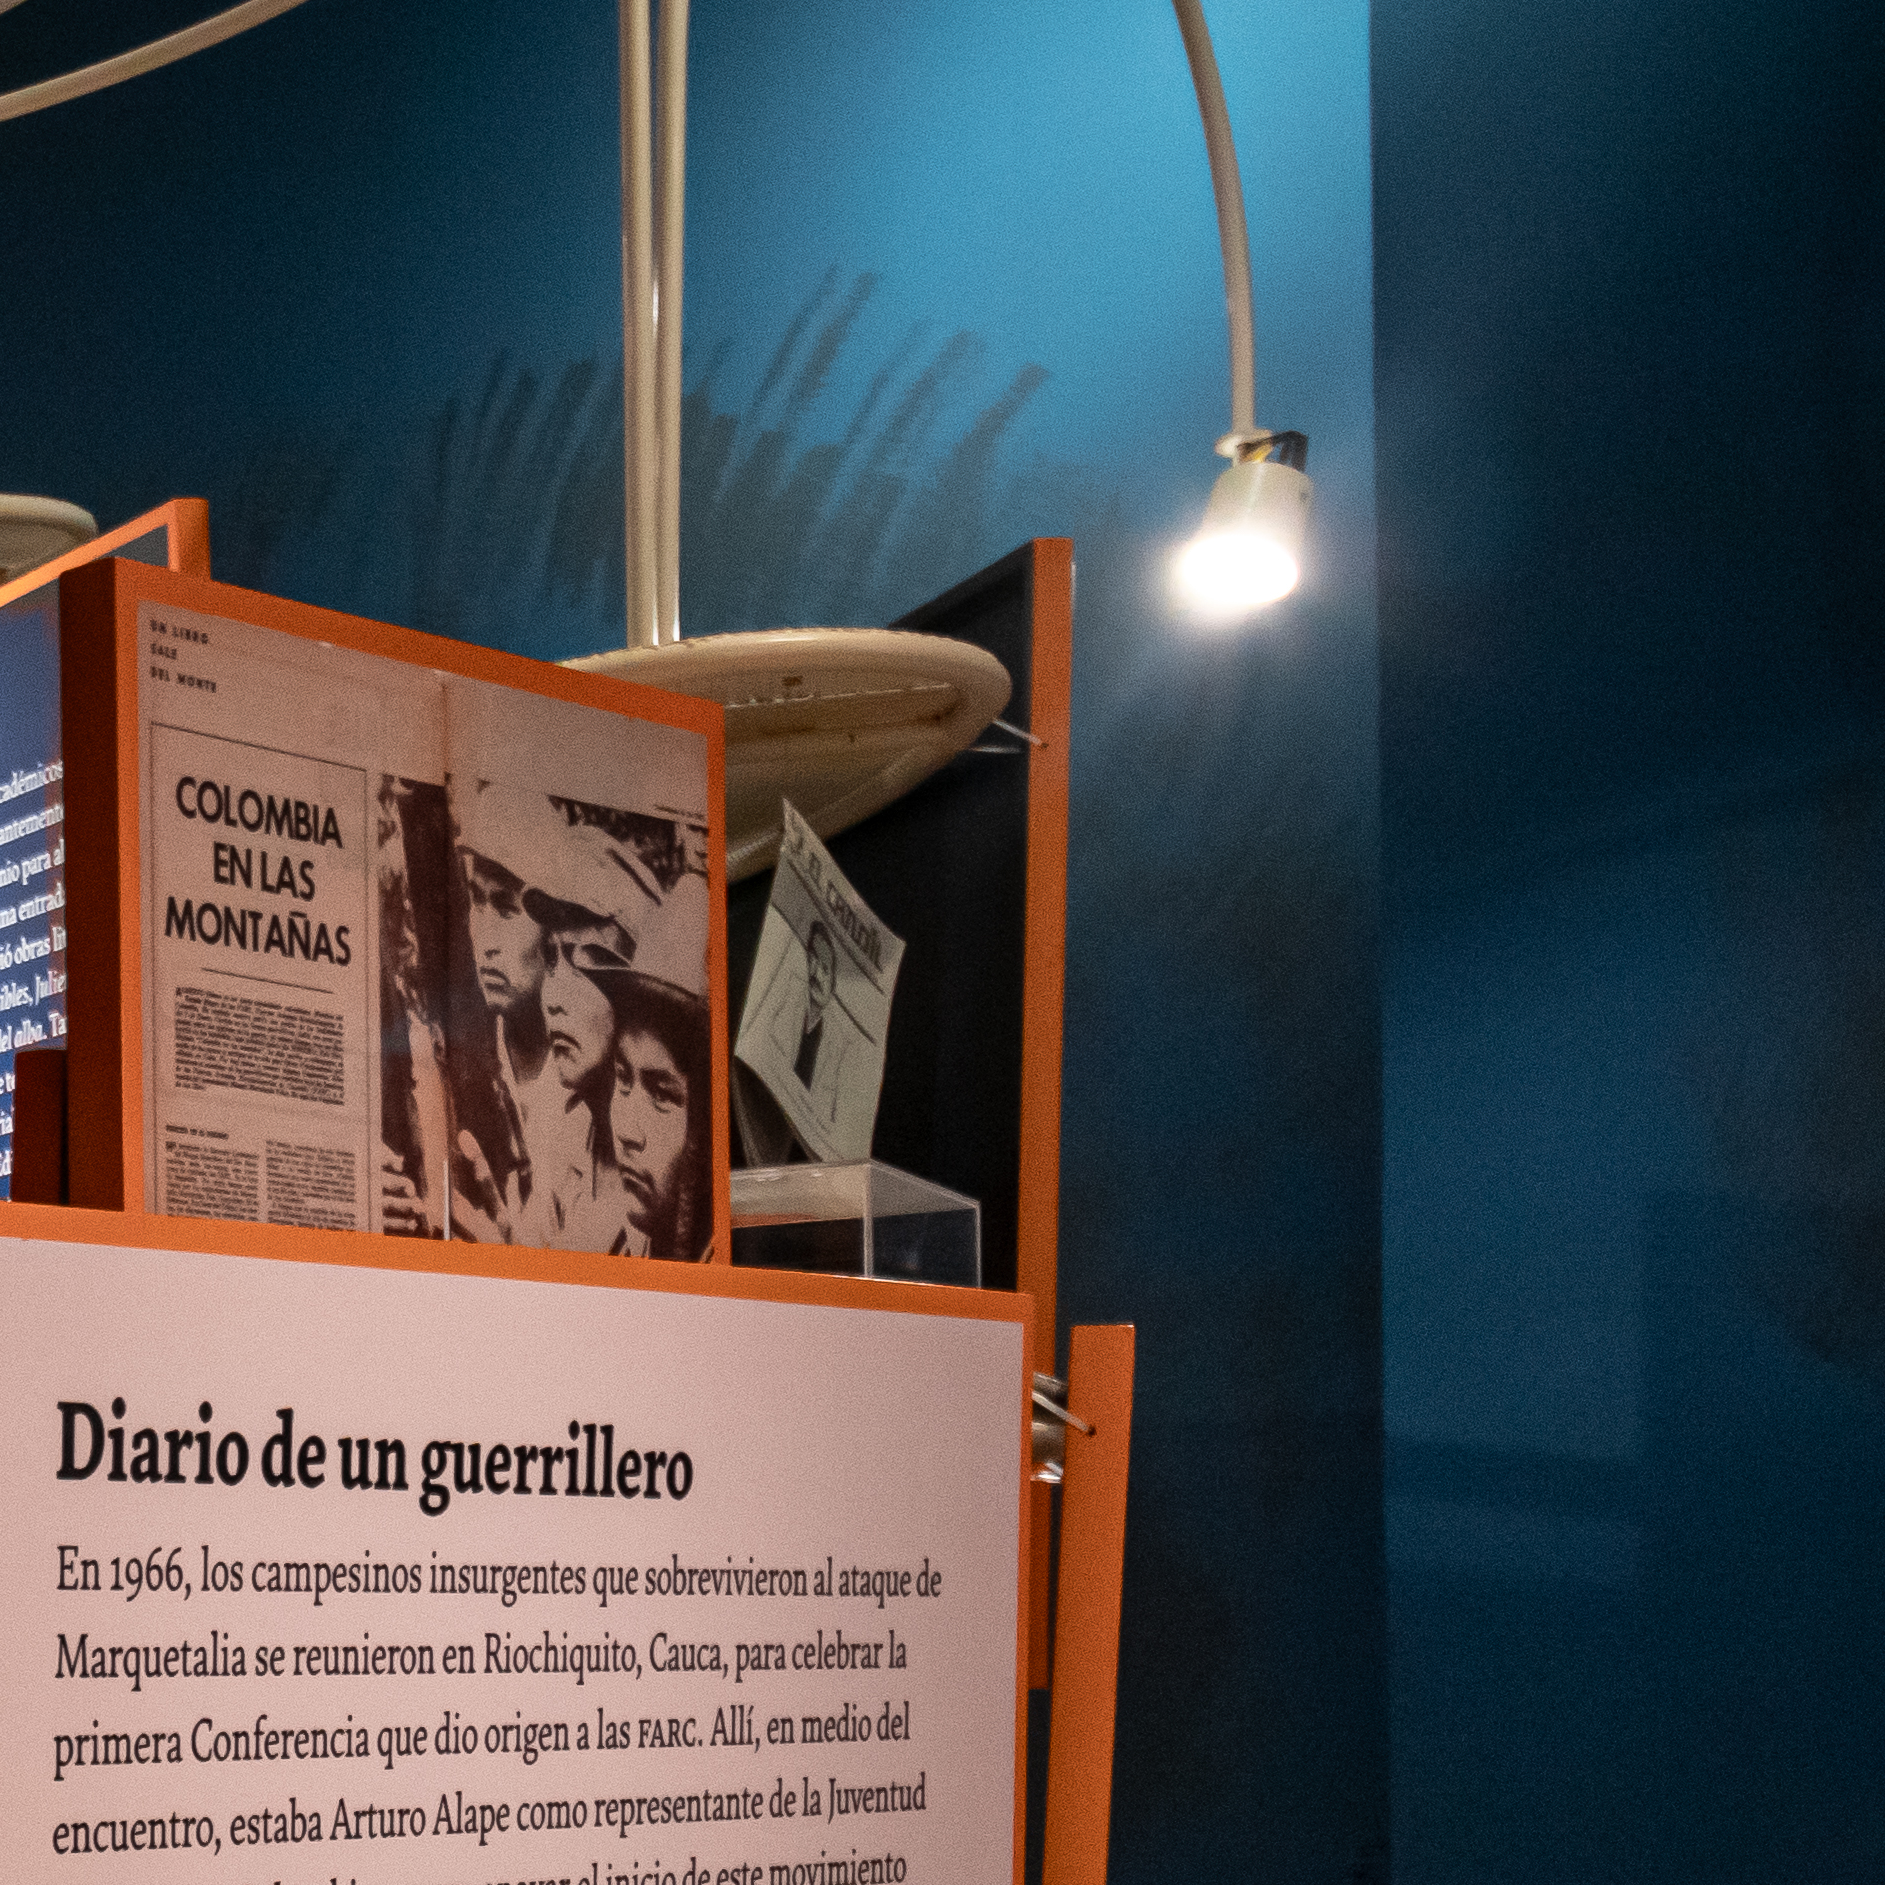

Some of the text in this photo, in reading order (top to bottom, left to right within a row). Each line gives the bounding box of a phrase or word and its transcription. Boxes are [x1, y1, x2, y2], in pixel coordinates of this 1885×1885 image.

[175, 775, 344, 850] COLOMBIA
[212, 839, 316, 902] EN LAS
[164, 896, 352, 967] MONTAÑAS
[55, 1395, 695, 1517] Diario de un guerrillero
[56, 1544, 942, 1610] En 1966, los campesinos insurgentes que sobrevivieron al ataque de
[54, 1628, 908, 1693] Marquetalia se reunieron en Riochiquito, Cauca, para celebrar la
[53, 1700, 911, 1783] primera Conferencia que dio origen a las FARC. Allí, en medio del
[51, 1770, 927, 1856] encuentro, estaba Arturo Alape como representante de la Juventud
